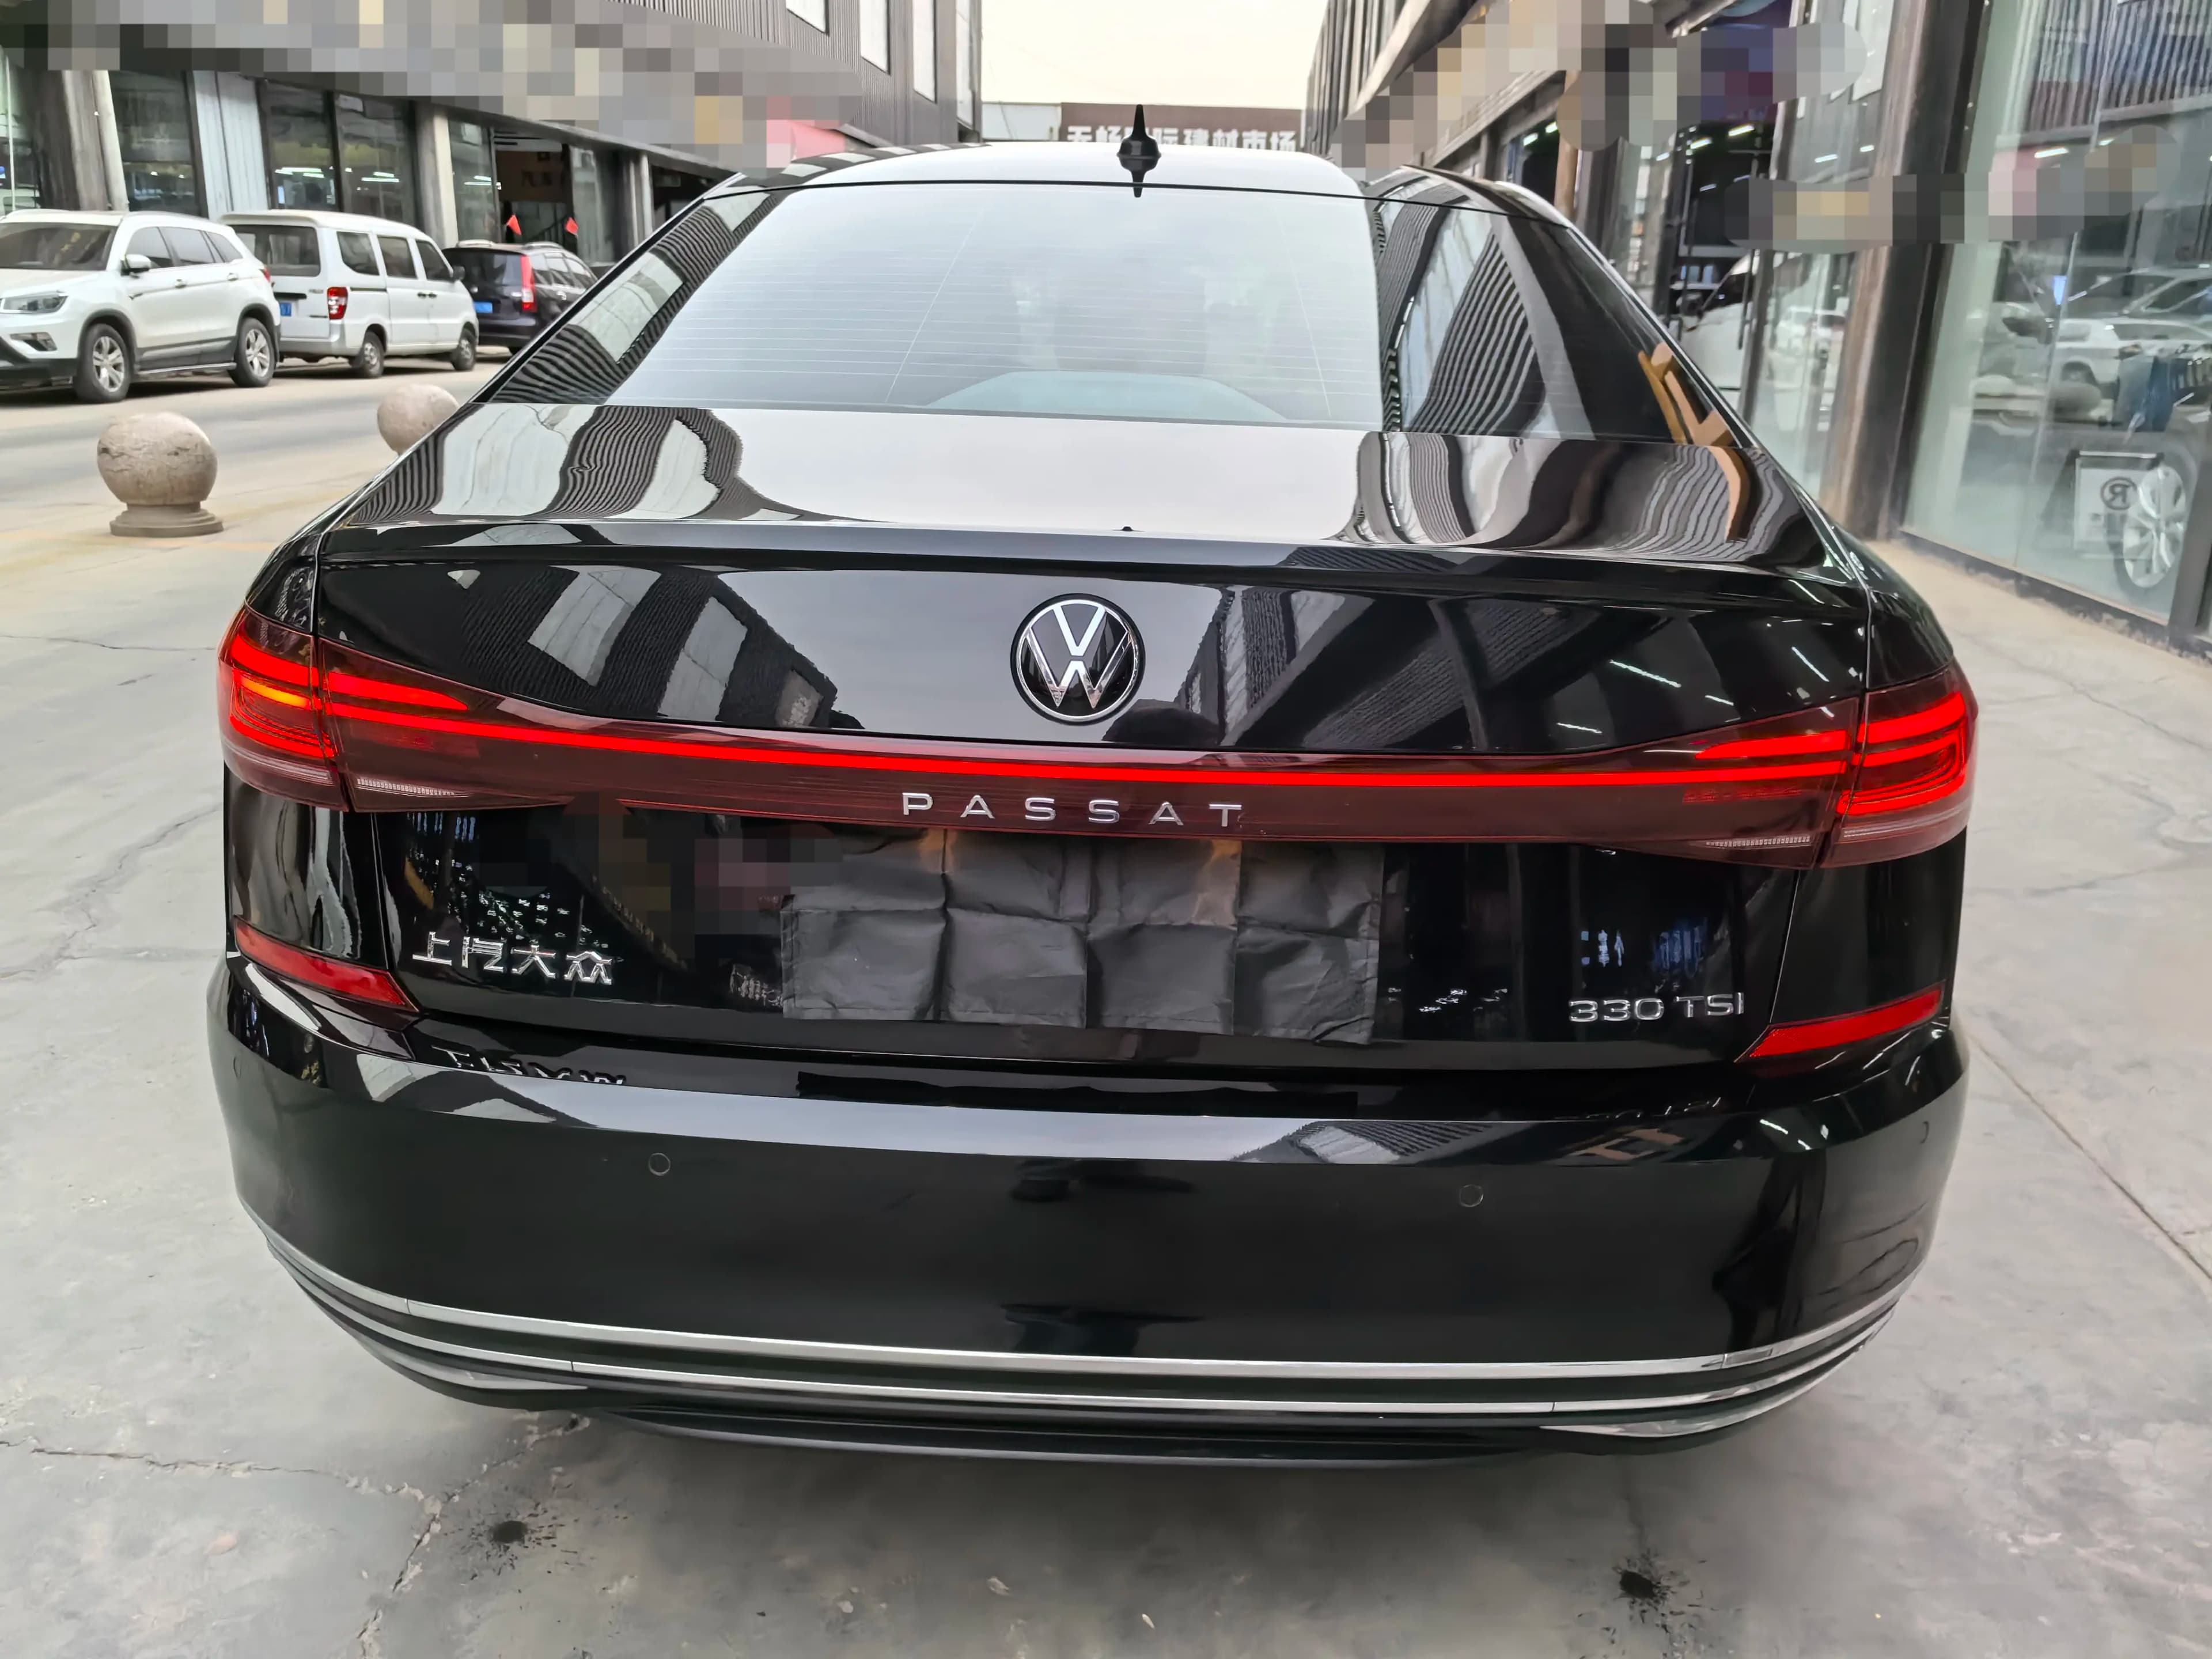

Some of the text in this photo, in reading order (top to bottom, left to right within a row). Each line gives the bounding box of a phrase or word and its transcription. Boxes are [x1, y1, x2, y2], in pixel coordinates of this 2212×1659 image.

[1023, 601, 1134, 710] VW
[902, 792, 1242, 827] PASSAT
[412, 931, 612, 986] 上汽大众
[1568, 992, 1744, 1022] 330 TSI
